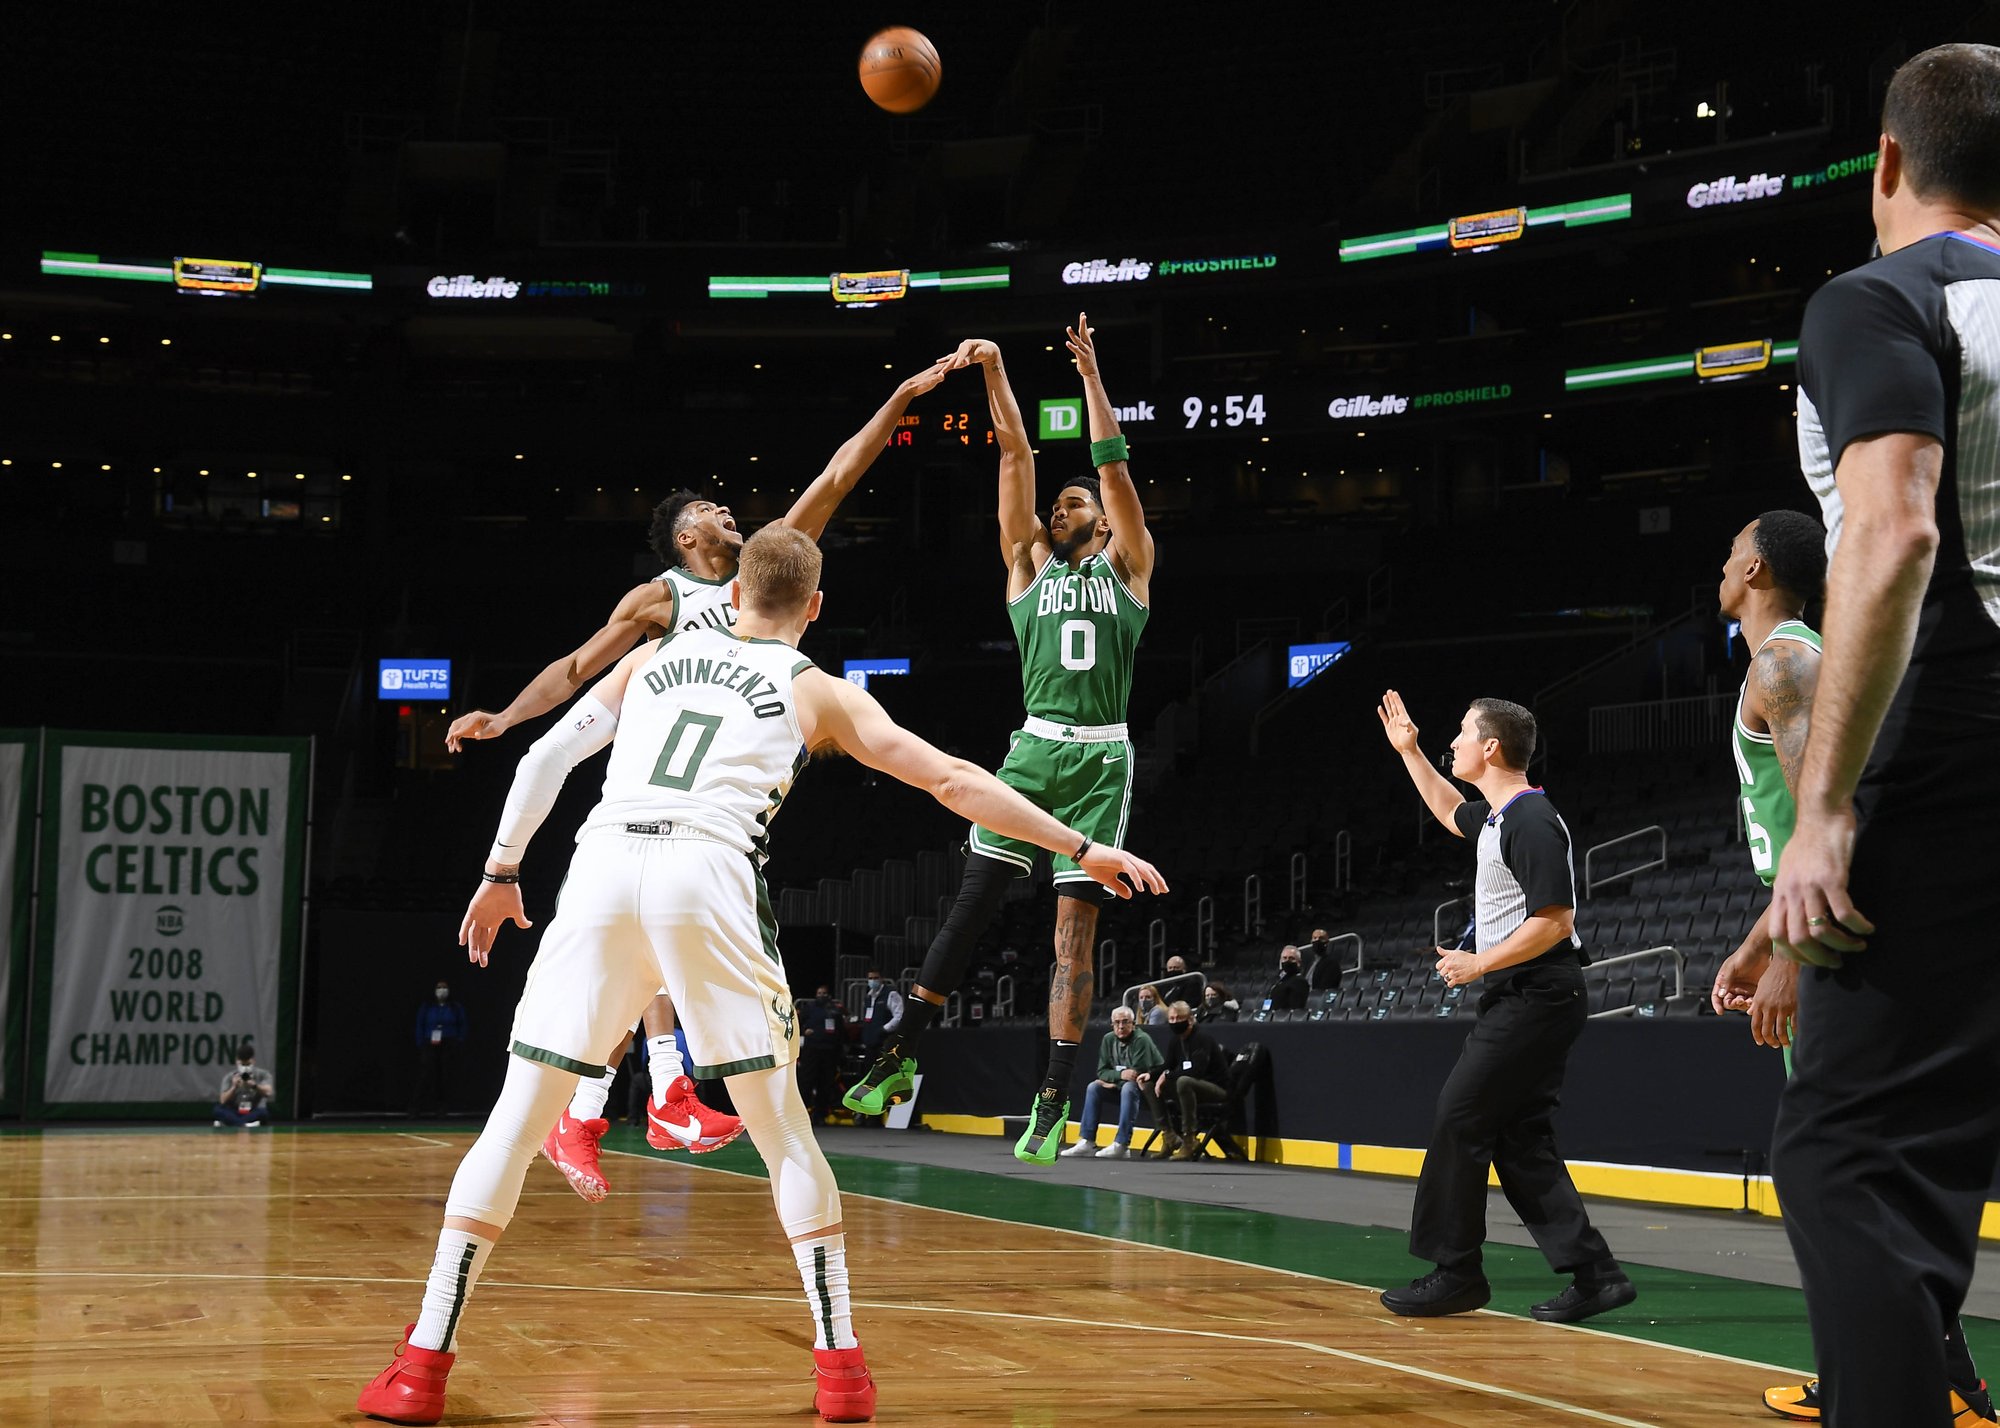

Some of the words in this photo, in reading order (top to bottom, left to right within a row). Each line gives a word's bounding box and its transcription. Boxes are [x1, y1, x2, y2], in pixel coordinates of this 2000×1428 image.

[1687, 172, 1785, 209] Gillette
[427, 275, 521, 299] Gillette
[1062, 257, 1152, 285] Gillette
[1043, 405, 1078, 431] TD
[1112, 400, 1156, 422] ank
[1182, 394, 1267, 429] 9:54
[1328, 394, 1408, 419] Gillette
[1413, 384, 1512, 409] #PROSHIELD
[1037, 575, 1118, 617] BOSTON
[1061, 619, 1096, 671] 0
[403, 669, 448, 681] TUFTS
[644, 658, 785, 719] DIVINCENZO
[648, 709, 724, 791] 0
[81, 783, 270, 836] BOSTON
[85, 844, 259, 896] CELTICS
[156, 915, 184, 928] NBA
[128, 947, 203, 980] 2008
[110, 990, 224, 1023] WORLD
